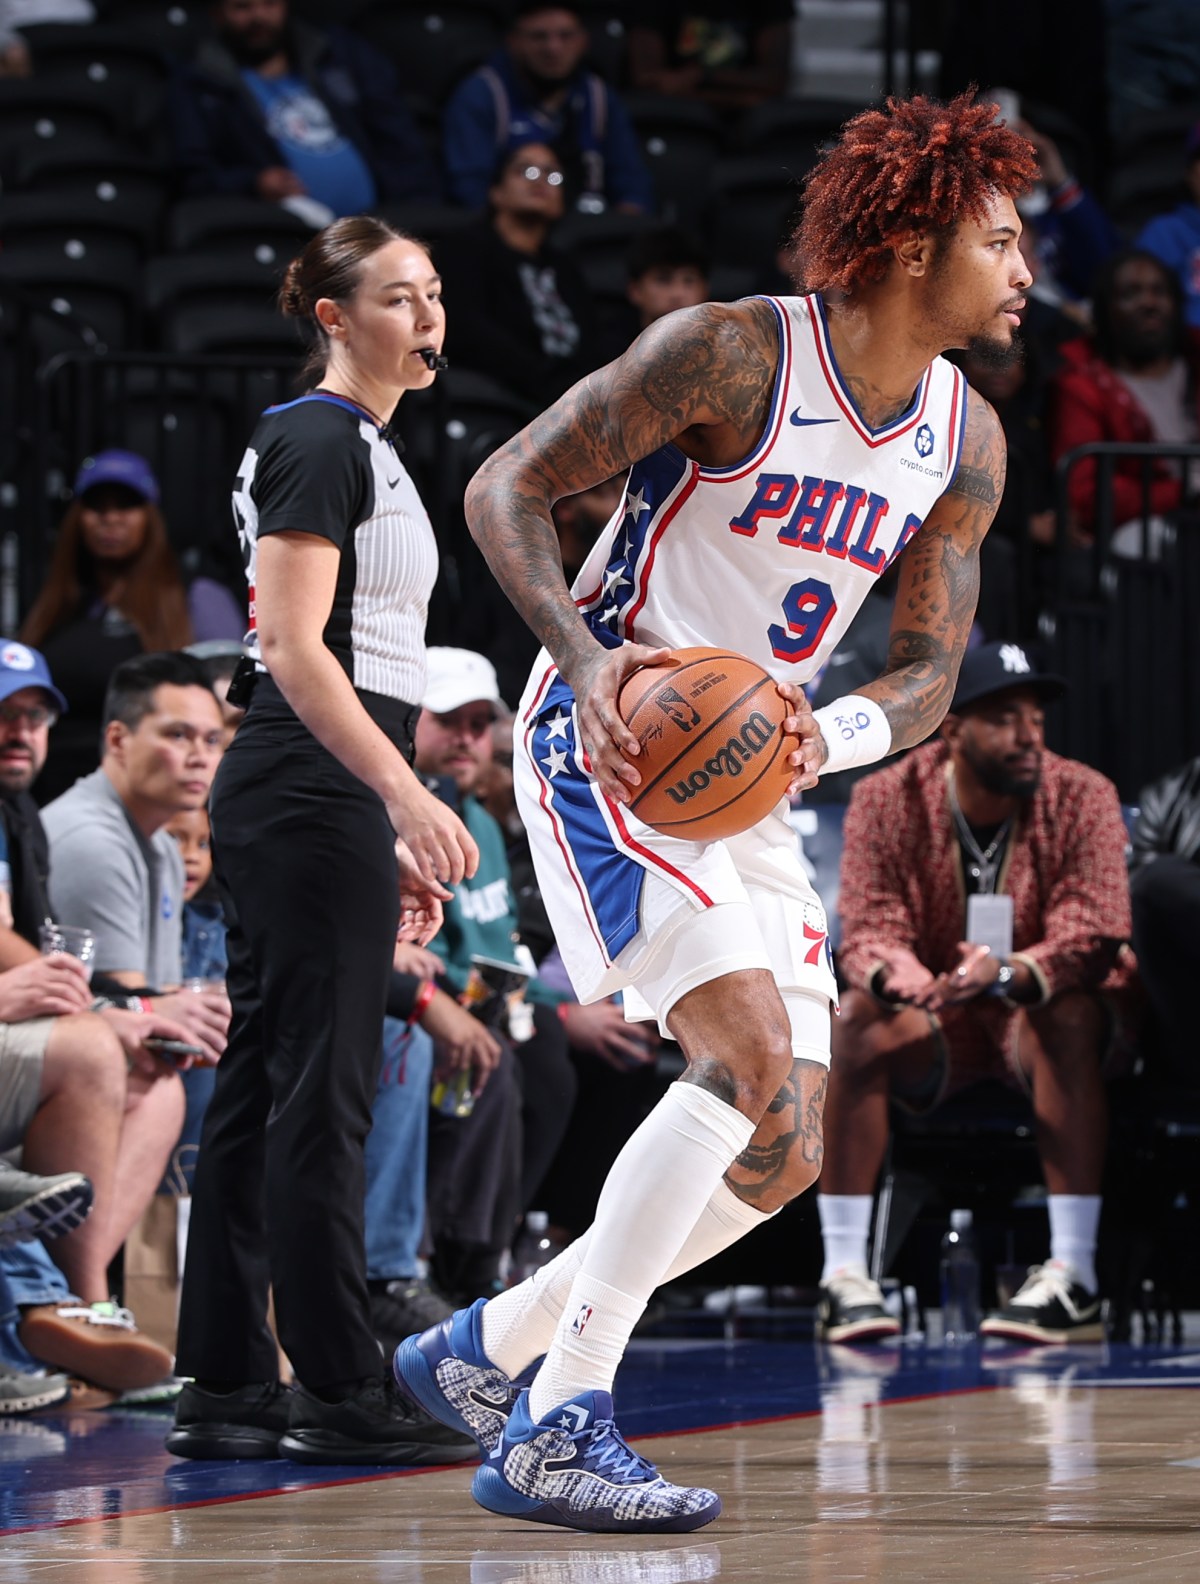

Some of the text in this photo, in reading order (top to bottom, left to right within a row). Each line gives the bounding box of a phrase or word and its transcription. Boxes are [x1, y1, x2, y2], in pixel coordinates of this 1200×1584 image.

[899, 457, 943, 479] crypto.com
[767, 577, 838, 664] 9
[850, 711, 871, 731] 9
[664, 710, 777, 805] Wilson
